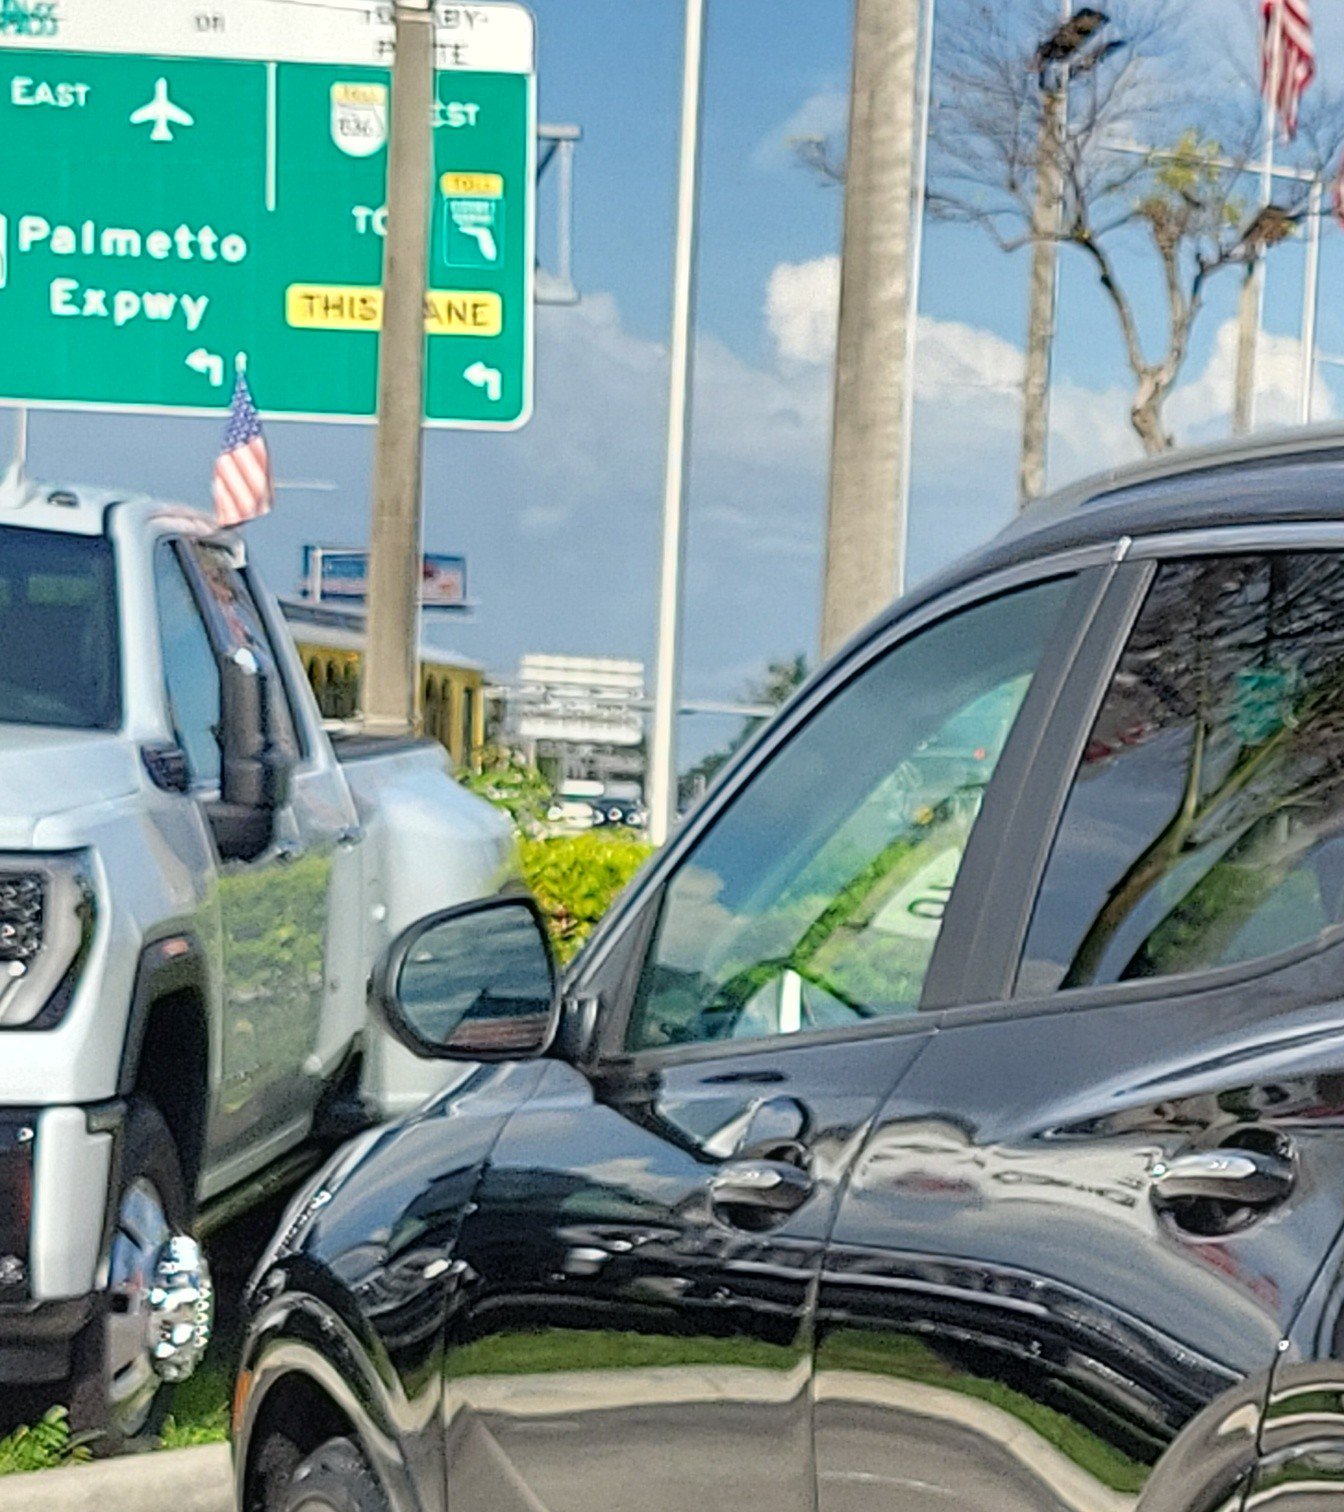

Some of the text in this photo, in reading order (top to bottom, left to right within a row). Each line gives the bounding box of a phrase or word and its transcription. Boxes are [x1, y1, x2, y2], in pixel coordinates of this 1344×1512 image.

[10, 75, 91, 108] EAST
[430, 101, 481, 129] EST
[18, 214, 248, 263] Palmetto
[49, 276, 210, 332] Expwy
[301, 293, 491, 328] THIS ANE
